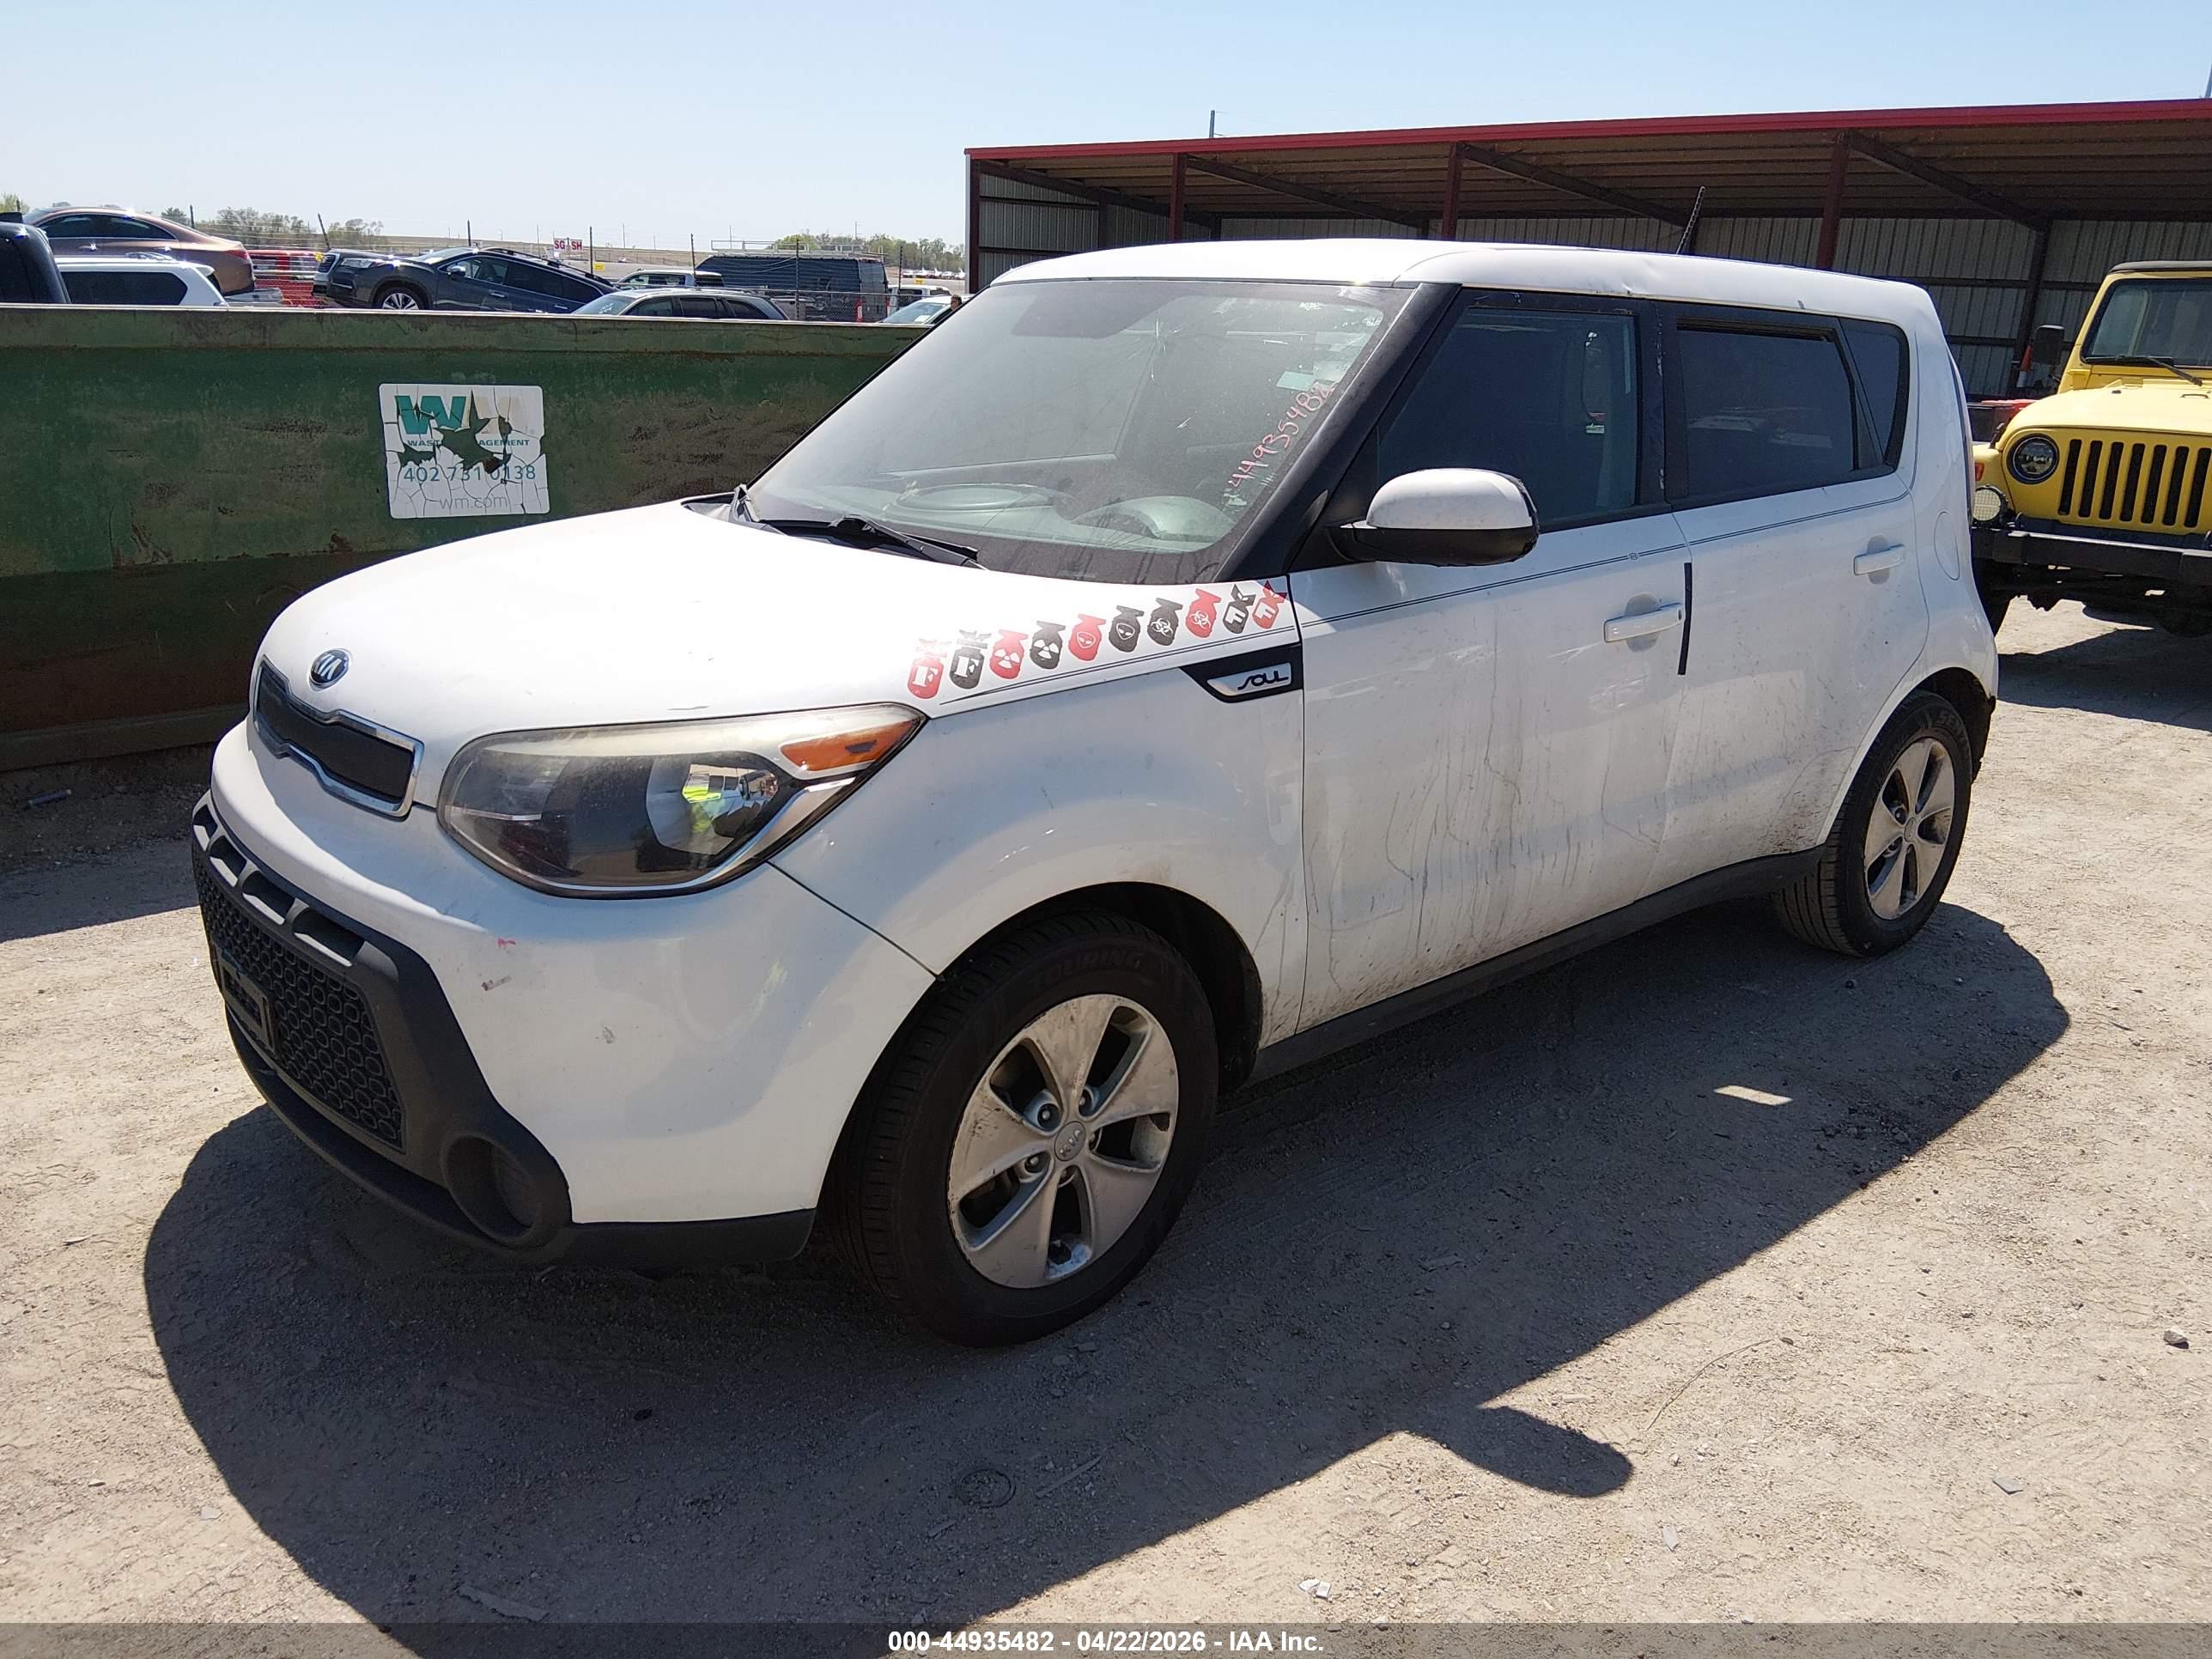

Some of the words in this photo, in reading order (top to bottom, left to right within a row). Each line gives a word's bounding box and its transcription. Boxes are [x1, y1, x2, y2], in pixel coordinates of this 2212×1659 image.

[554, 240, 566, 249] SG
[571, 240, 583, 250] SH
[1228, 381, 1338, 487] 44935482
[407, 439, 442, 447] WAST
[404, 466, 441, 482] 402
[447, 466, 482, 481] 731
[489, 465, 536, 481] 0138
[439, 496, 508, 509] wm.com
[1237, 670, 1290, 690] SOUL
